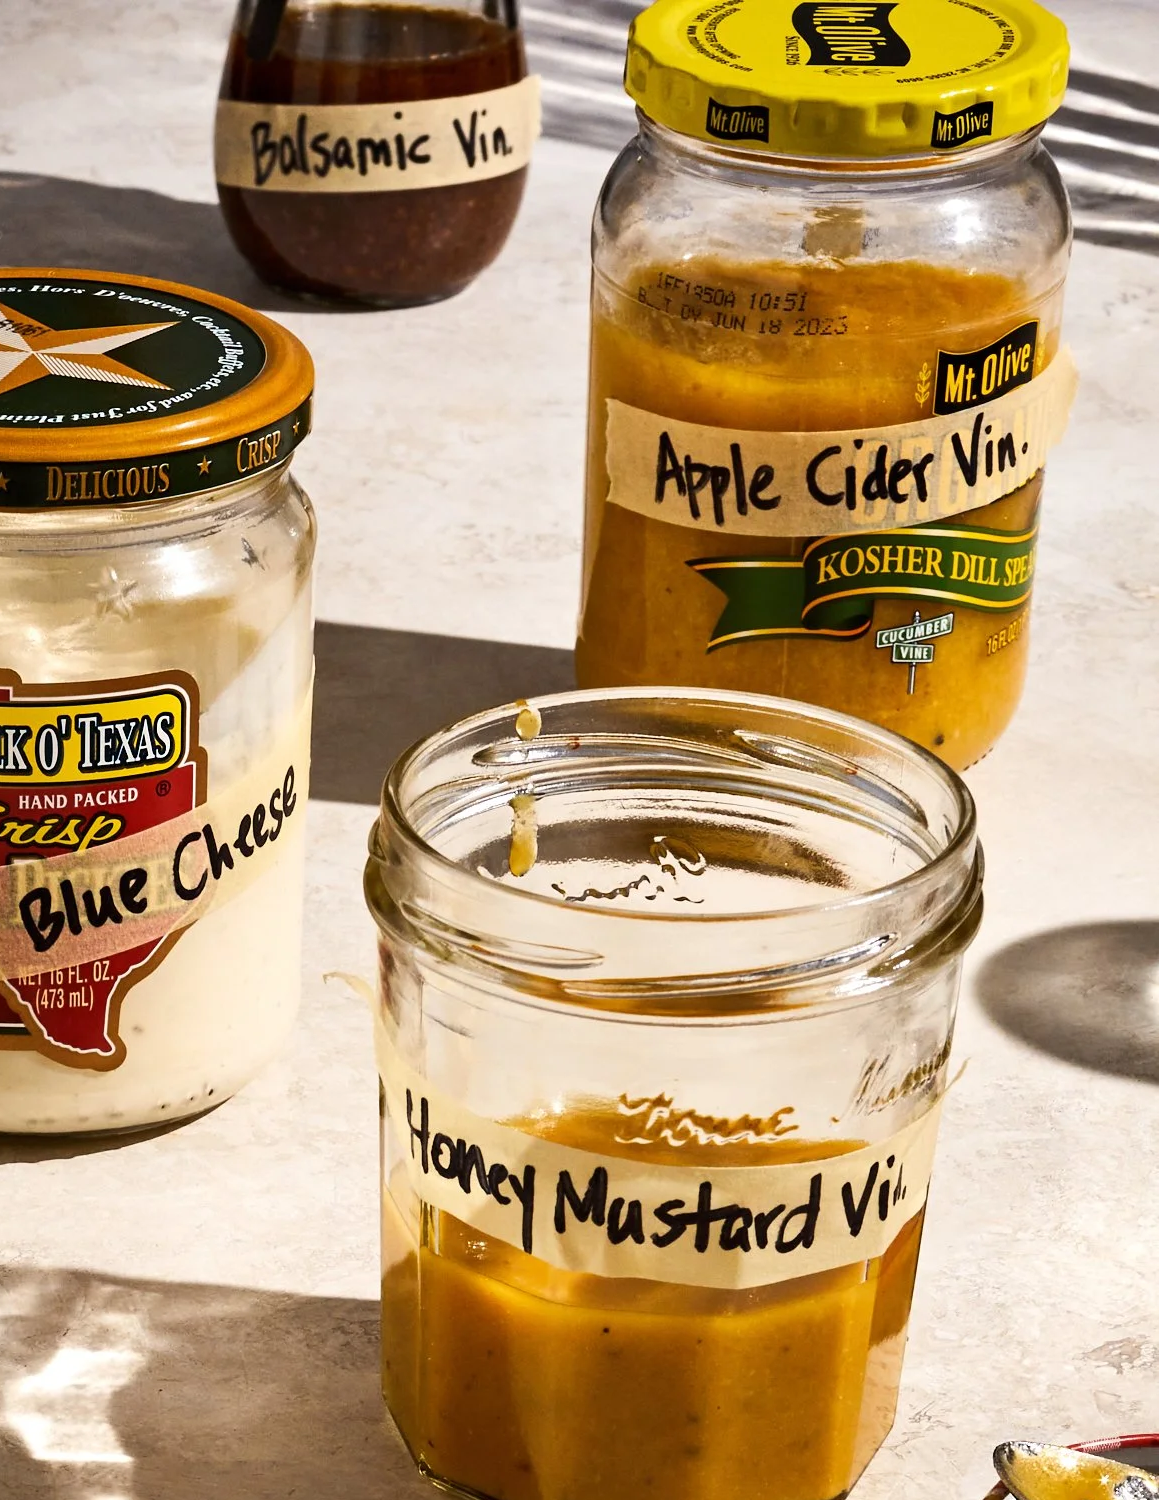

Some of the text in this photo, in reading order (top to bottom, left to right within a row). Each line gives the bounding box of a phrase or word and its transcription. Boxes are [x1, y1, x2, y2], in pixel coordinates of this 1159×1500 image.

[785, 35, 801, 52] SINCE
[814, 25, 888, 62] Olive
[710, 106, 766, 134] Mt. Olive
[936, 111, 990, 142] Mt. Olive
[251, 111, 432, 186] Balsamic
[28, 284, 86, 295] Hors
[749, 291, 809, 313] 10:51
[711, 311, 747, 333] JUN
[758, 319, 783, 335] 18
[944, 343, 1032, 403] Mt. Olive
[126, 399, 158, 415] for
[159, 391, 194, 409] and
[45, 462, 171, 502] DELICIOUS
[236, 429, 283, 474] CRISP
[654, 411, 1029, 526] Apple Cider Vin.
[815, 544, 1037, 588] KOSHER DILL SPEA
[880, 616, 950, 645] CUCUMBER
[986, 635, 998, 655] 16
[899, 645, 930, 660] VINE
[37, 717, 69, 772] O'
[77, 714, 172, 768] TEXAS
[18, 787, 139, 810] HAND PACKED
[19, 867, 149, 953] Blue
[172, 764, 298, 902] Cheese
[50, 967, 64, 986] 16
[67, 963, 89, 985] FL.
[92, 959, 115, 983] OZ.
[35, 984, 95, 1015] (473 mL)
[405, 1087, 537, 1255] Honey
[553, 1165, 823, 1255] Mustard
